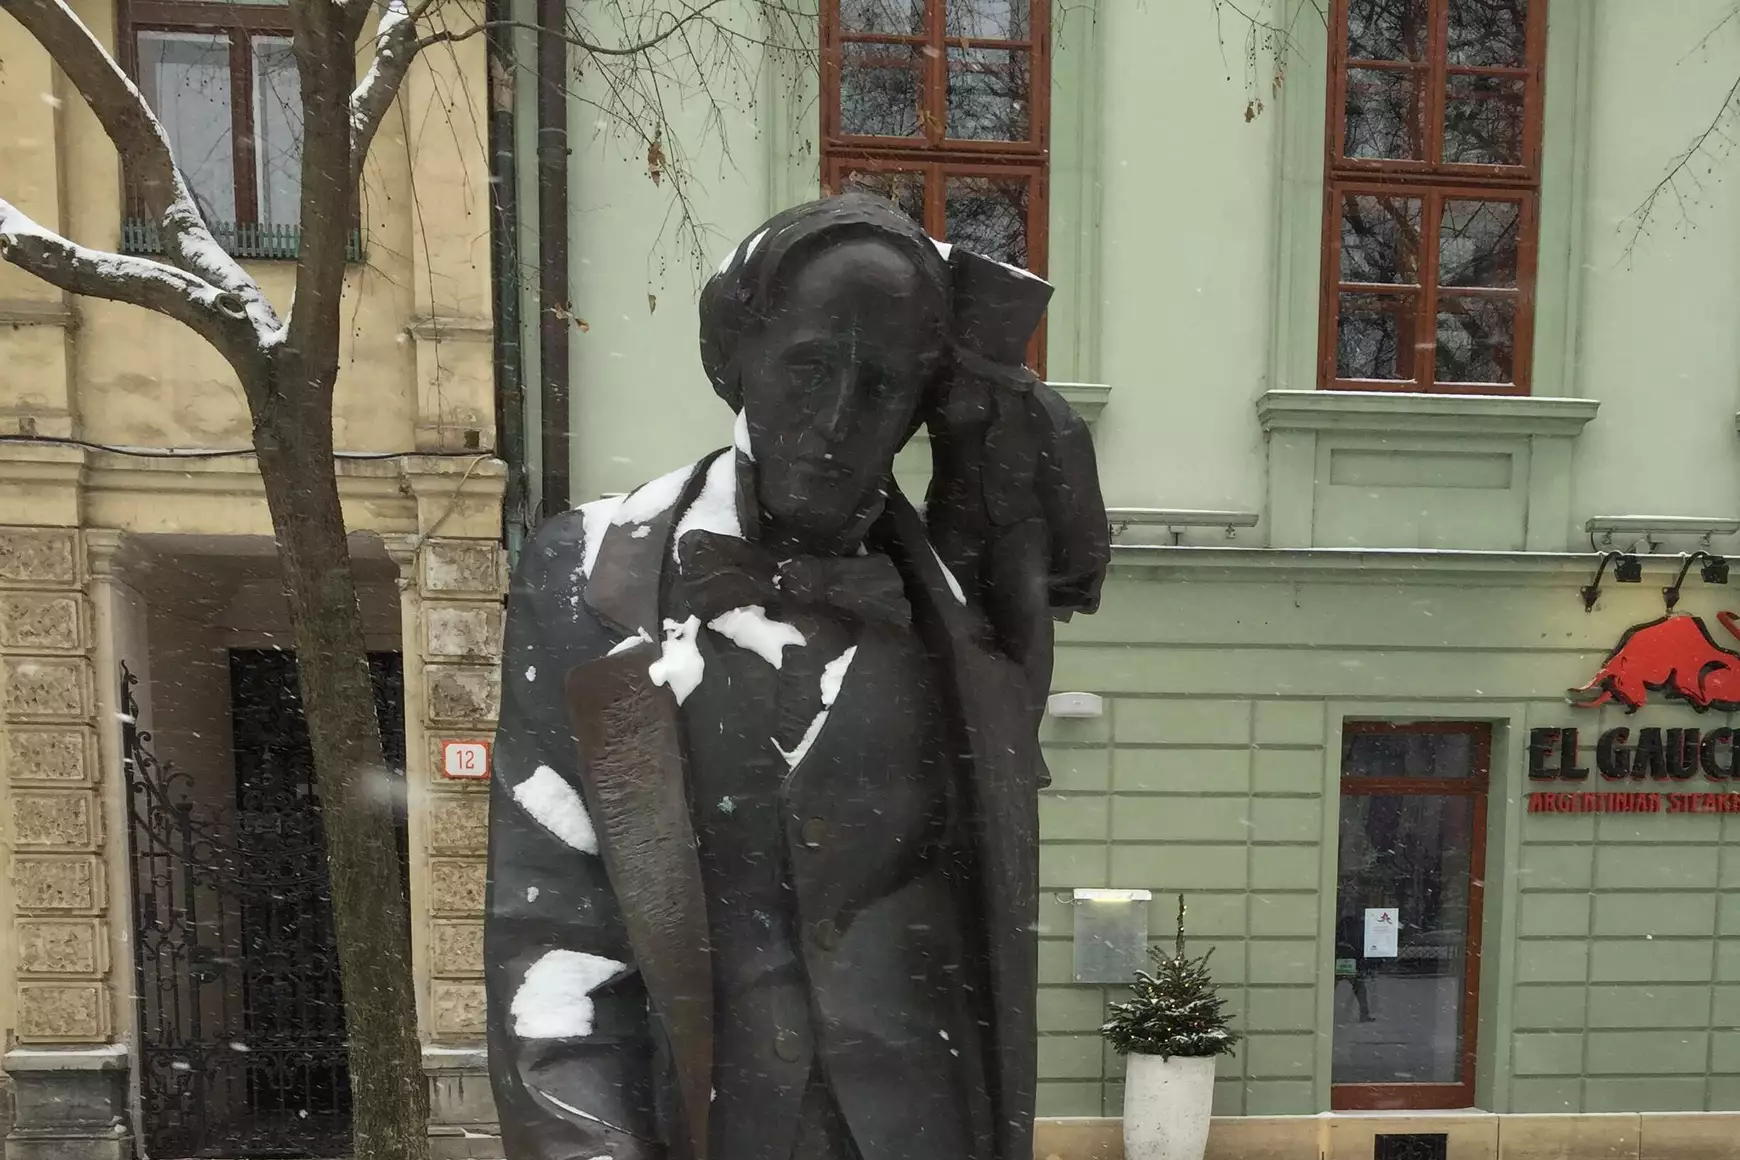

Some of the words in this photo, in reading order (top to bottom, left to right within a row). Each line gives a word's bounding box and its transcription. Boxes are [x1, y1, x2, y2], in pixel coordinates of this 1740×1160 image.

[456, 750, 475, 770] 12
[1528, 727, 1589, 782] EL
[1528, 792, 1661, 814] ARGENTINIAN
